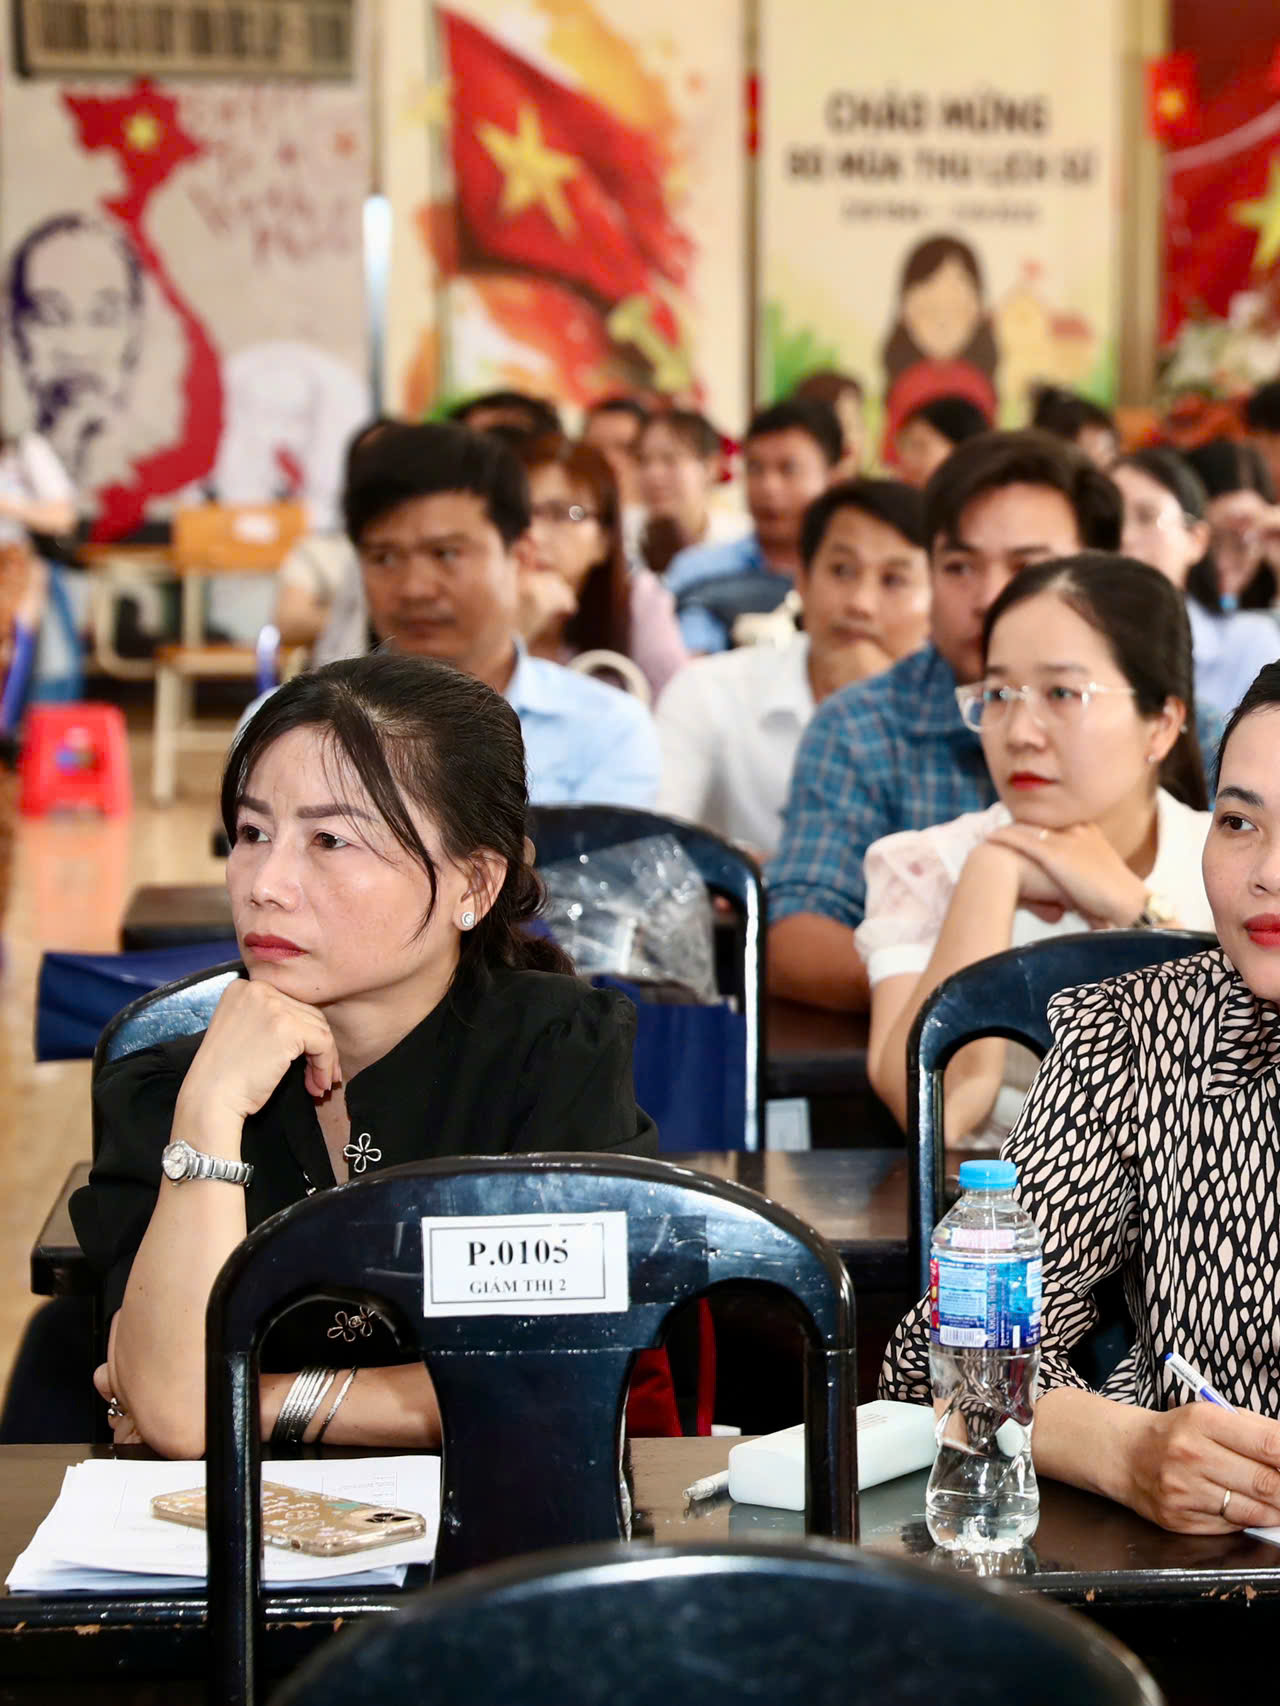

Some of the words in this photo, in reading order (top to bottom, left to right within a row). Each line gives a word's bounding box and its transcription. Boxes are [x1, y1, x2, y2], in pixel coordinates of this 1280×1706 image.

[468, 1238, 568, 1266] P.0105
[469, 1275, 517, 1294] GIÁM
[523, 1279, 553, 1294] THỊ
[559, 1279, 567, 1291] 2
